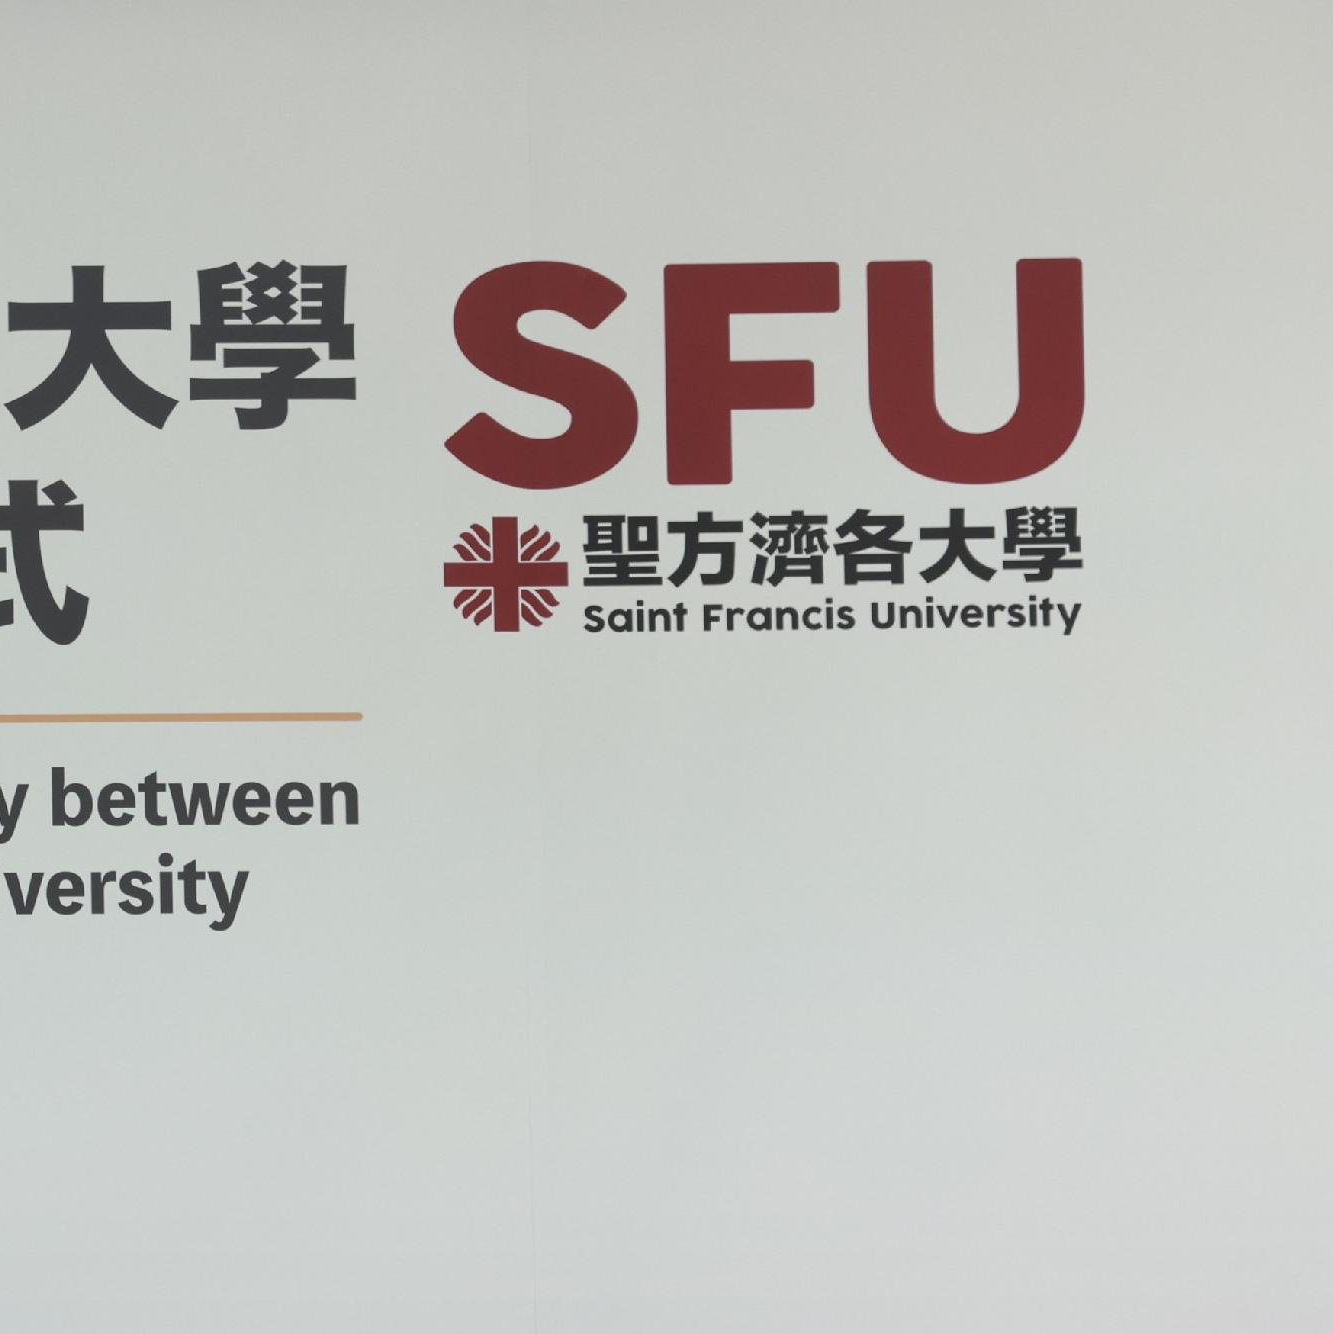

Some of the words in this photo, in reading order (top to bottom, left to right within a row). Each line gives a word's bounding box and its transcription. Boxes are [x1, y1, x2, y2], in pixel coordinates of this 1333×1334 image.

[444, 258, 1084, 490] SFU
[582, 506, 1083, 587] 聖方濟各大學
[583, 599, 688, 633] Saint
[703, 597, 856, 632] Francis
[871, 594, 1082, 636] University
[51, 767, 360, 828] between
